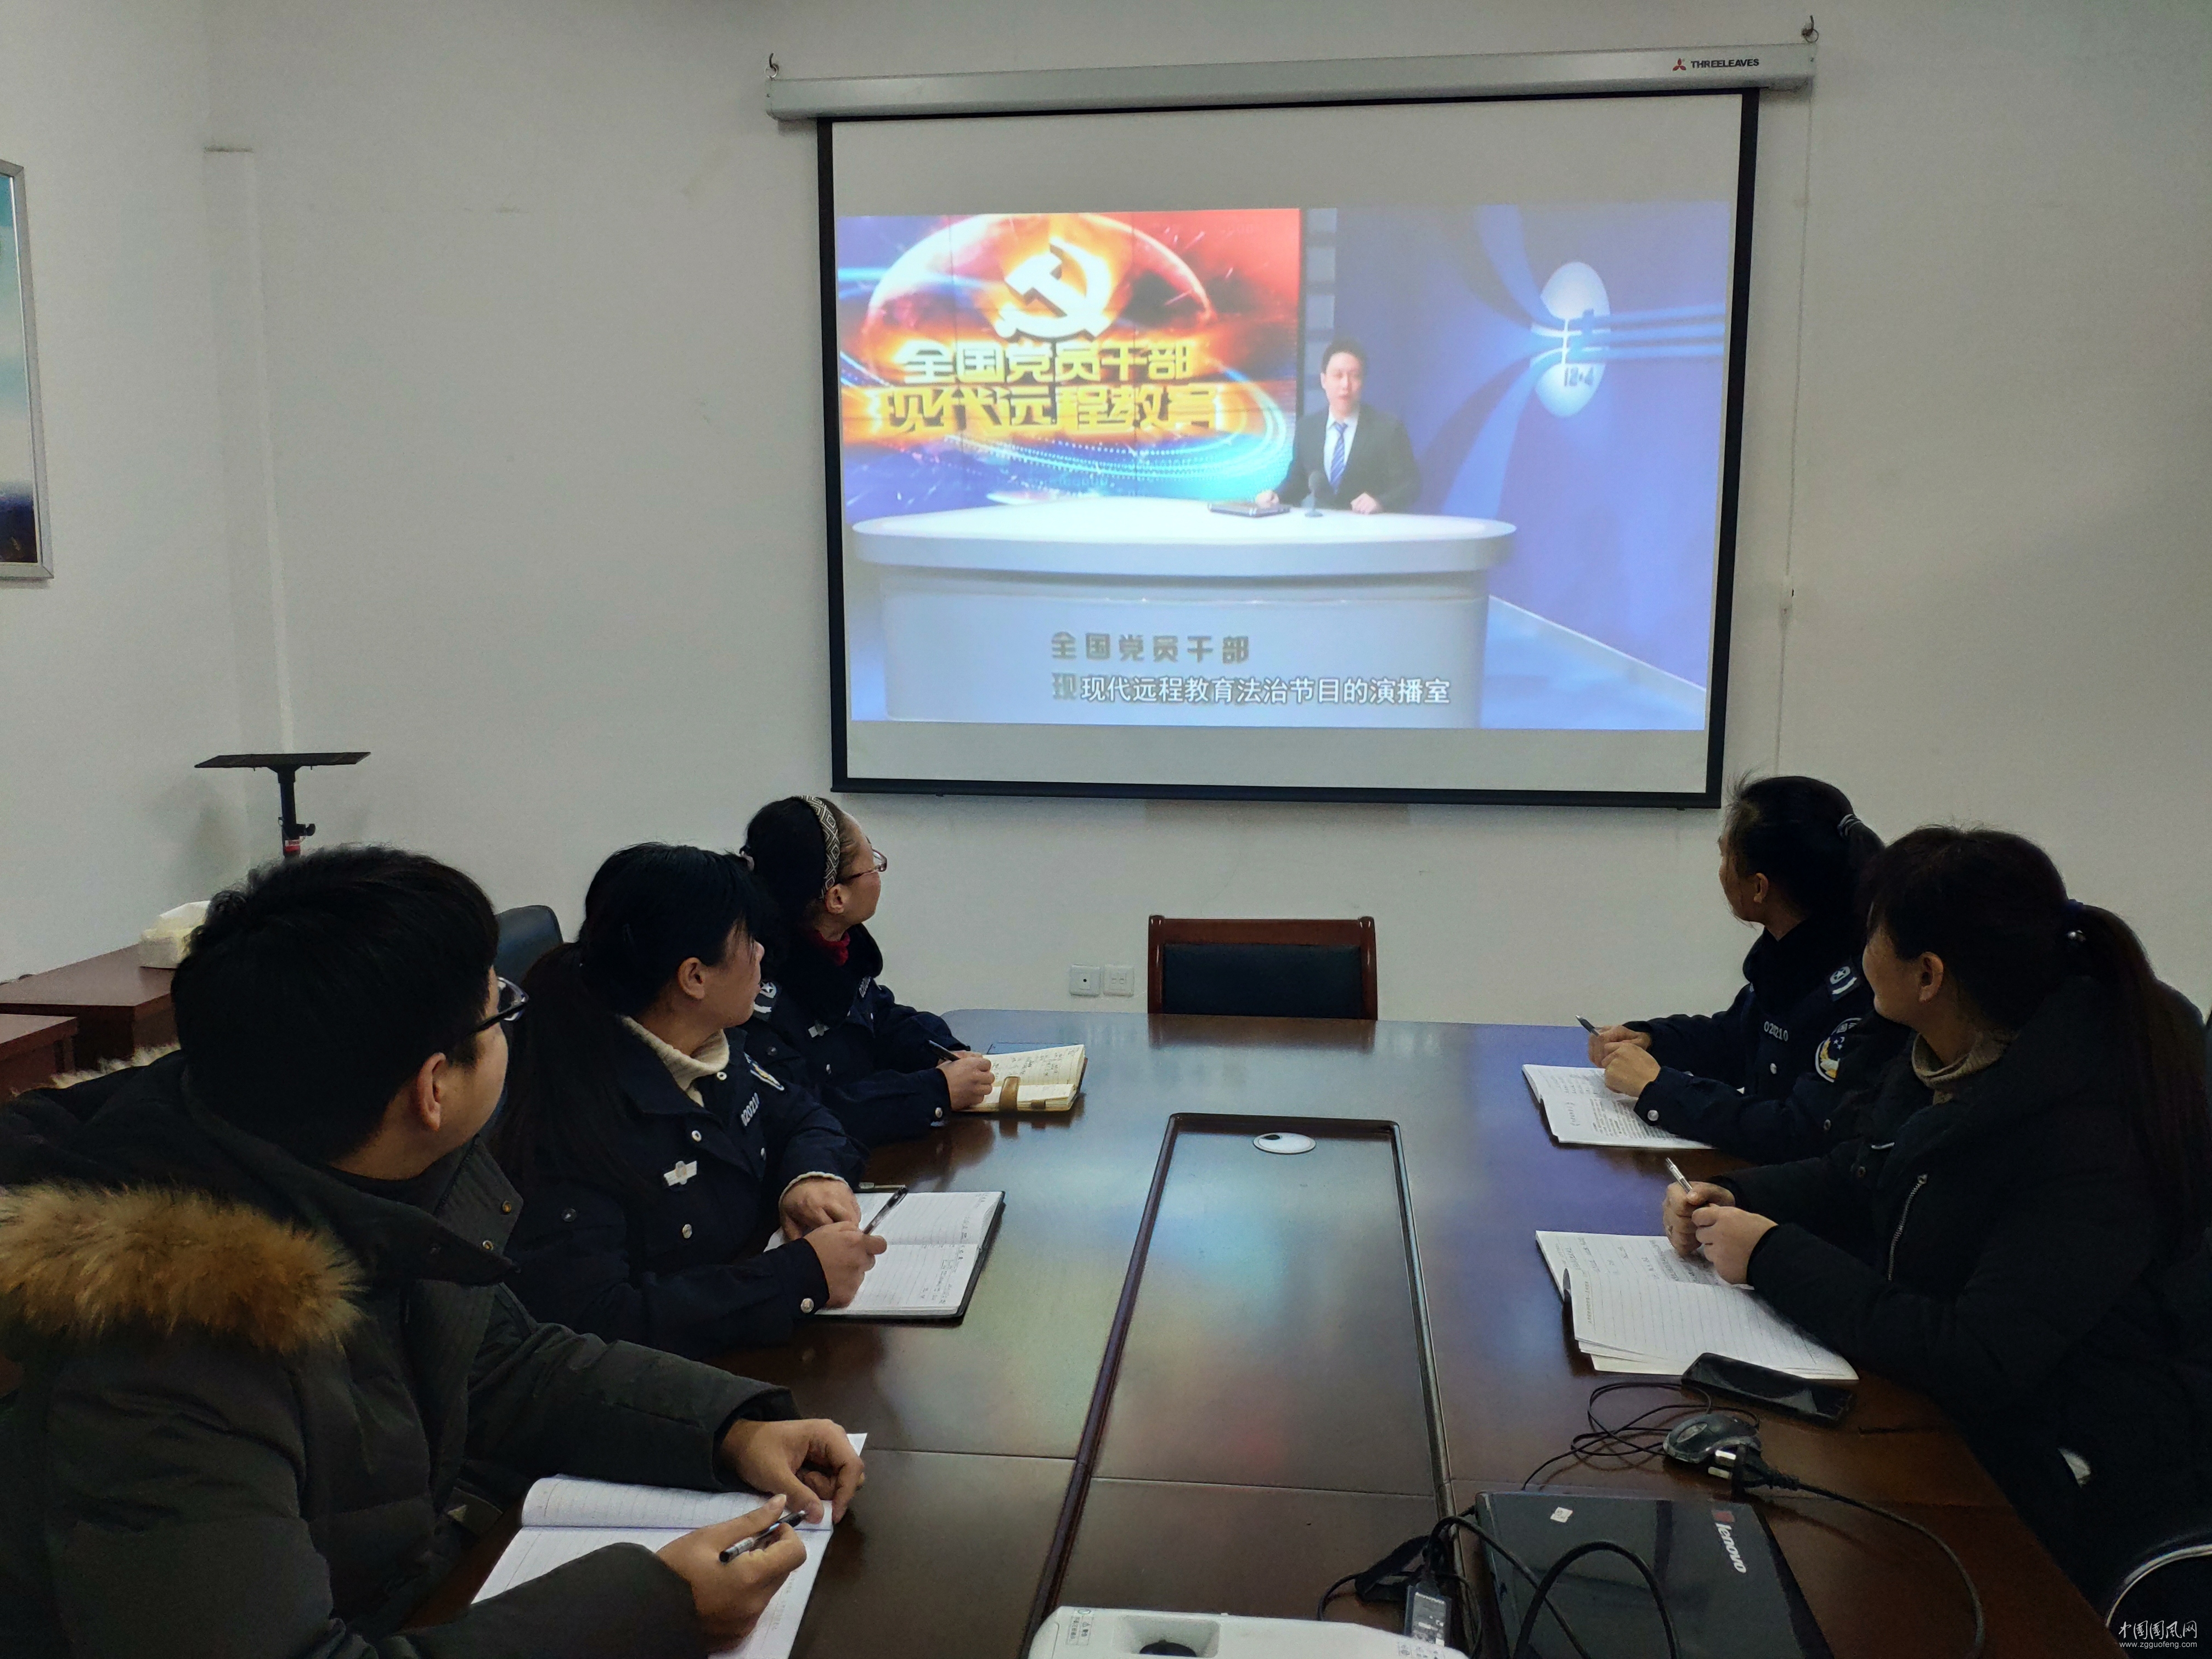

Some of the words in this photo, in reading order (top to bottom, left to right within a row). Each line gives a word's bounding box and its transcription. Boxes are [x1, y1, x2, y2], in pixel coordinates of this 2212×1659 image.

[1690, 58, 1759, 69] THREELEAVES
[903, 340, 1193, 383] 全国党员干部
[879, 383, 1219, 435] 现代远程教育
[1051, 631, 1250, 664] 全国党员干部
[1081, 676, 1451, 705] 现代远程教育法治节目的演播室
